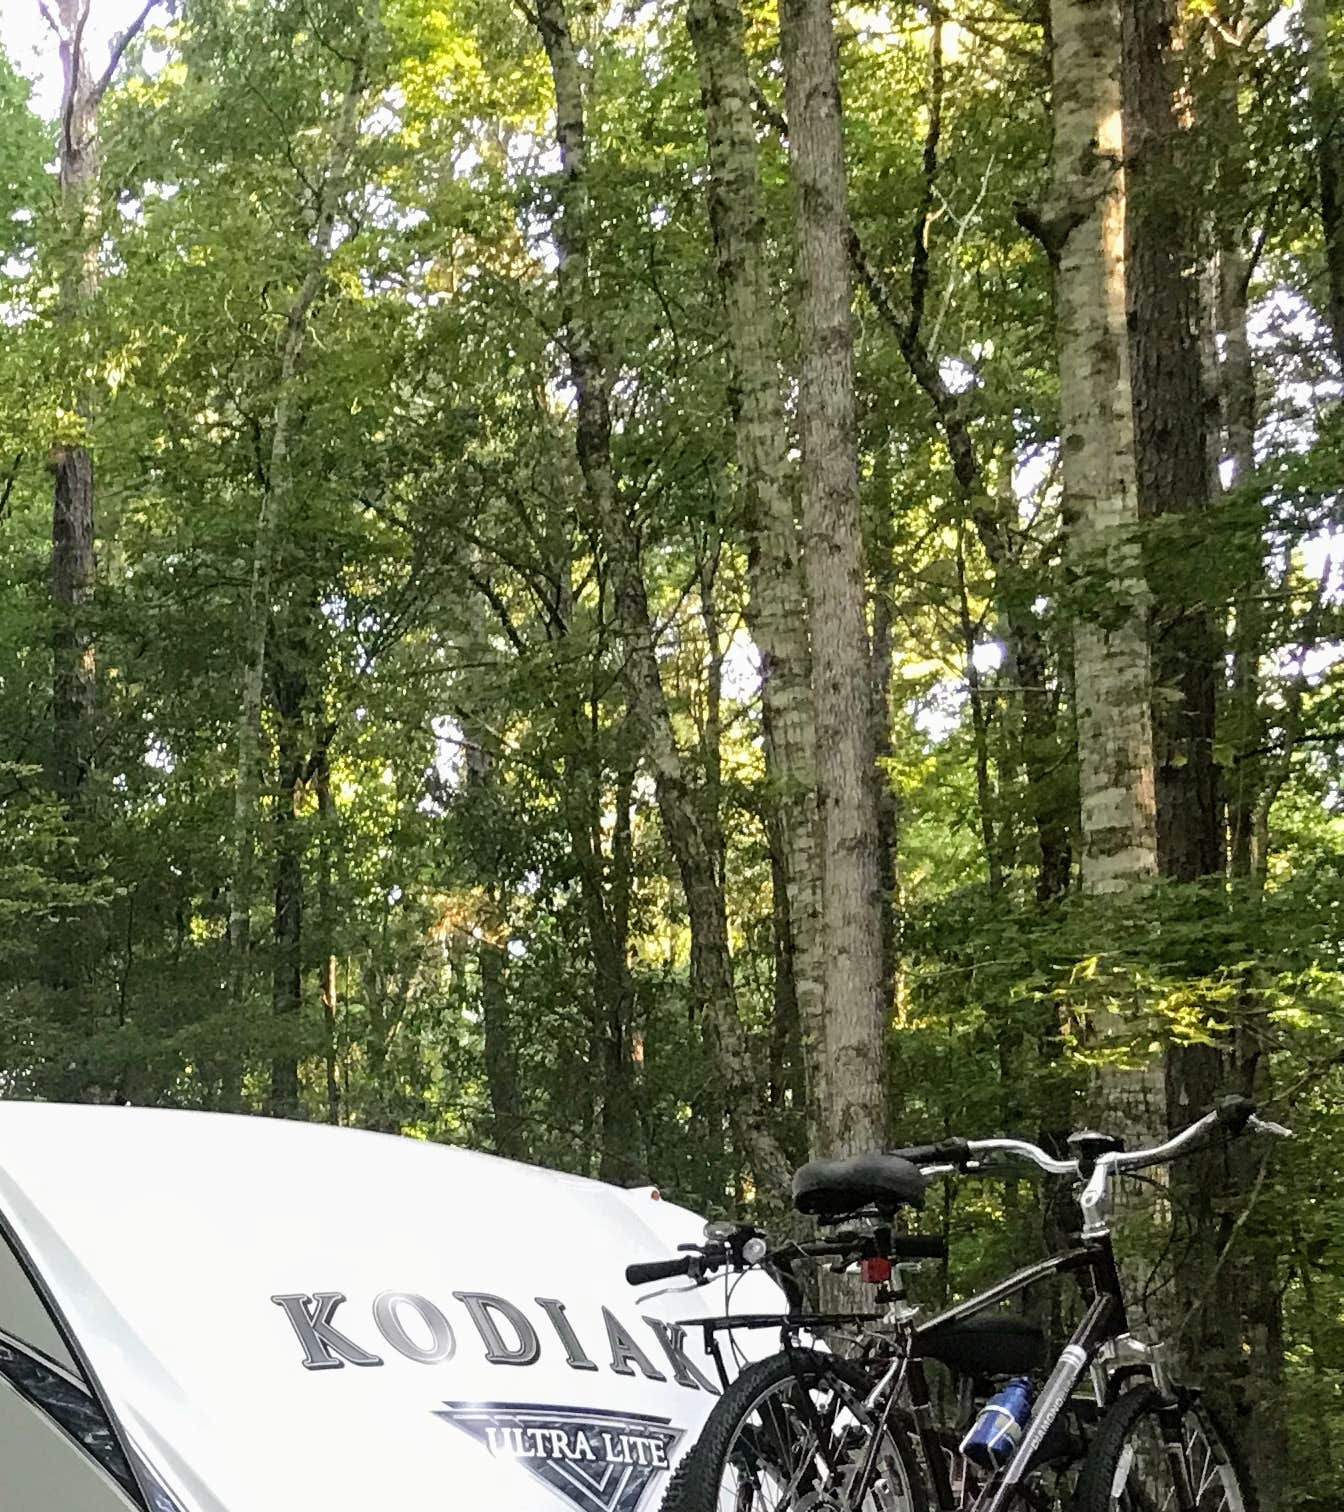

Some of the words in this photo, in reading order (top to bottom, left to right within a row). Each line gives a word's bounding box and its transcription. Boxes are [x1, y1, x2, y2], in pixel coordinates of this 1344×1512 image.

[271, 1289, 721, 1397] KODIAK
[485, 1427, 597, 1461] ULTRA
[602, 1432, 670, 1469] LITE
